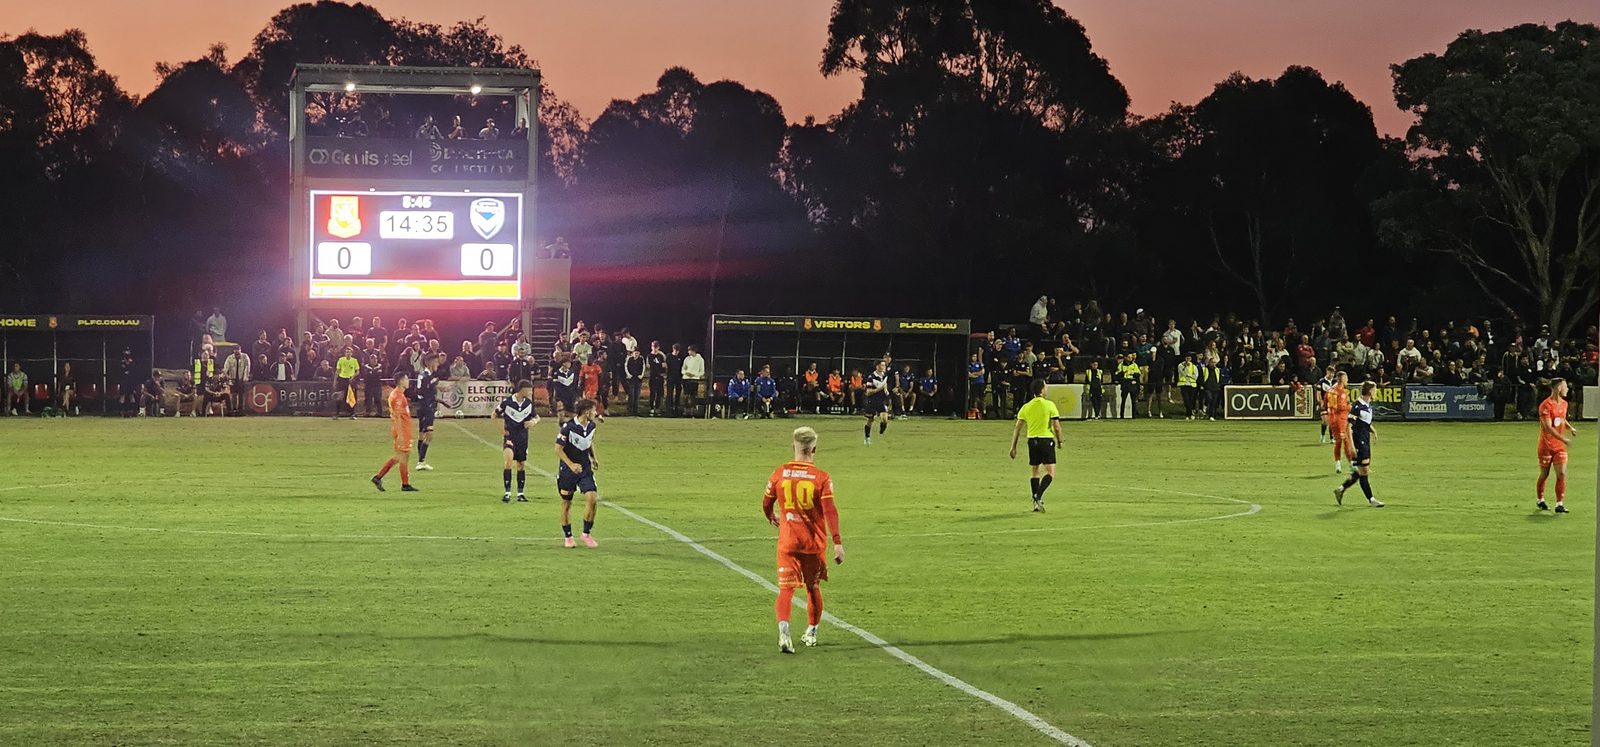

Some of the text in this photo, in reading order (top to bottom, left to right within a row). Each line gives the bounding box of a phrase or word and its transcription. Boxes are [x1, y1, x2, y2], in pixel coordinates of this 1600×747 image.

[386, 215, 448, 233] 14:35
[337, 246, 351, 270] 0
[480, 248, 494, 271] 0
[814, 320, 871, 329] VISITORS
[899, 322, 957, 330] PLFC.COM.AU
[1231, 393, 1291, 411] OCAM
[1410, 390, 1446, 402] Harvey
[1409, 402, 1448, 412] Norman
[1458, 403, 1486, 411] PRESTON
[781, 479, 815, 510] 10
